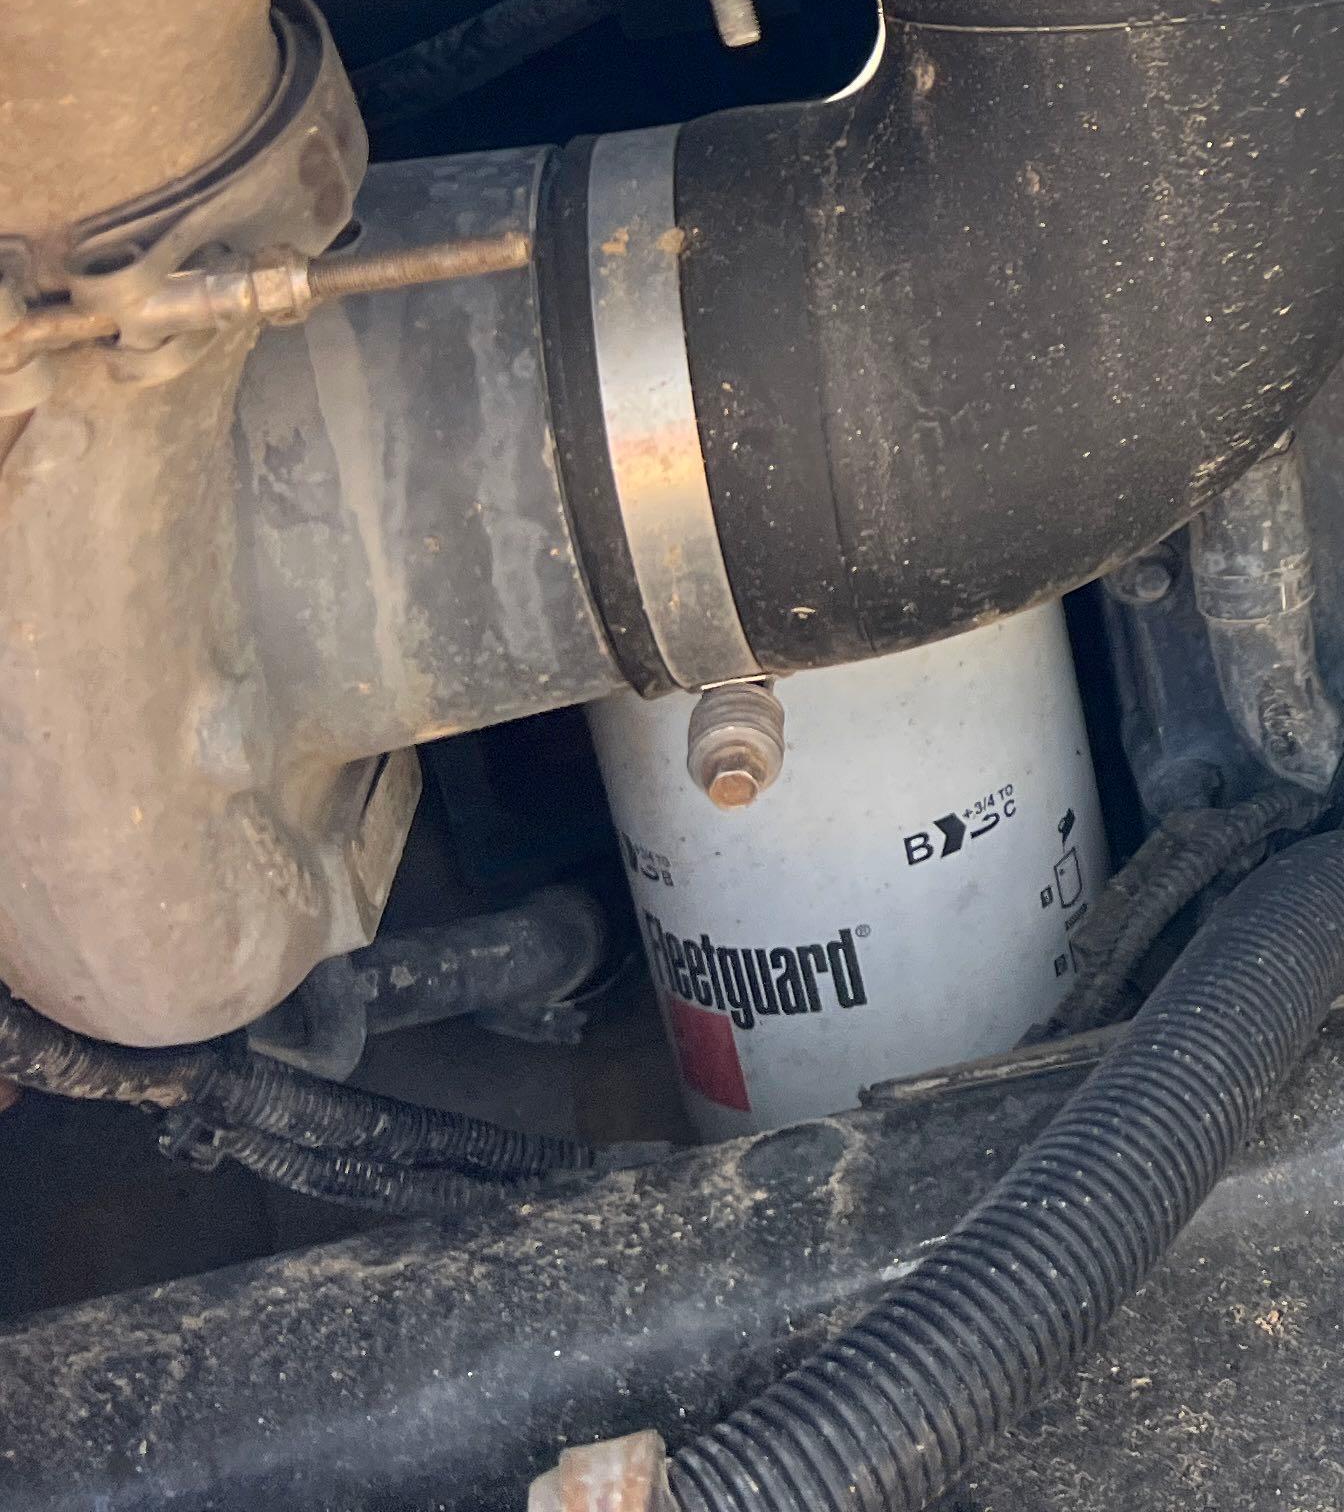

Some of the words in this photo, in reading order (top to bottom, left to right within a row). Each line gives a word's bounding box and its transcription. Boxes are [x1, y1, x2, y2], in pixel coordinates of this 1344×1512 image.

[998, 783, 1013, 800] TO
[1003, 799, 1017, 817] C
[903, 831, 934, 866] B
